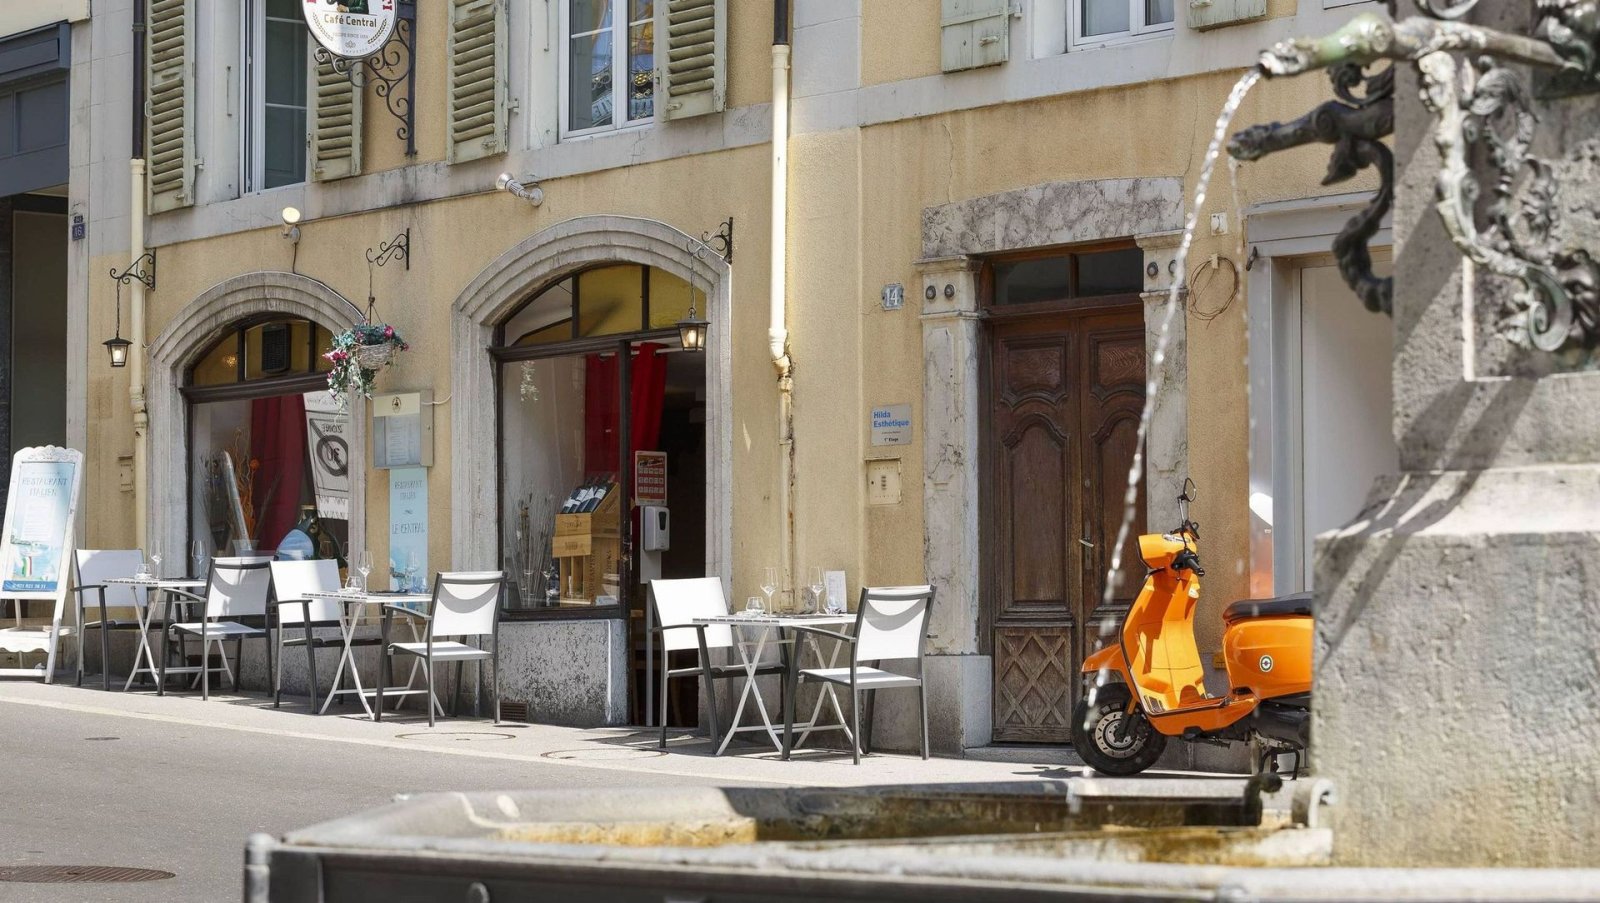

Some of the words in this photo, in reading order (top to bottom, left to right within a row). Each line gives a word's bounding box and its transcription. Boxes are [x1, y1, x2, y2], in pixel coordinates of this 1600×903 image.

[324, 13, 344, 24] Café
[346, 15, 377, 27] Central
[885, 288, 898, 307] 14
[873, 411, 891, 419] Hilda
[22, 477, 68, 486] RESTAURANT
[29, 487, 57, 497] ITALIEN
